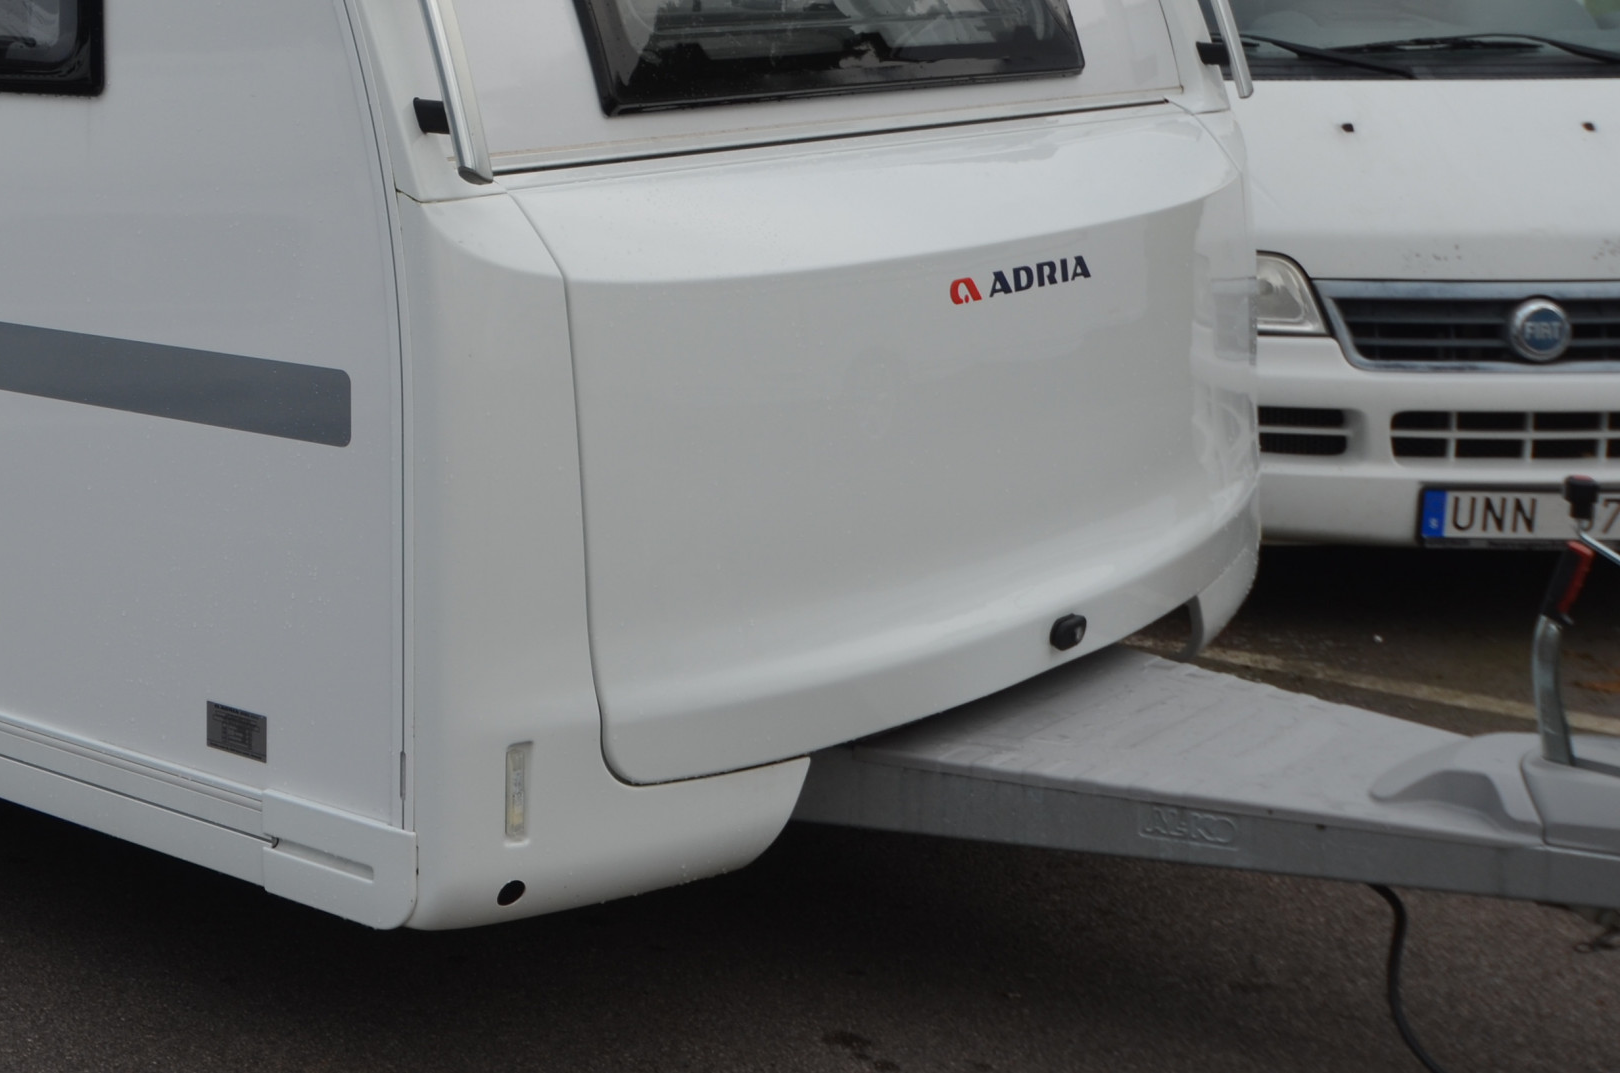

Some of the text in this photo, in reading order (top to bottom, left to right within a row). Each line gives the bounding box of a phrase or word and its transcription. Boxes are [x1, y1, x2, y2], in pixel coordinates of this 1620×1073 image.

[989, 255, 1091, 298] ADRIA
[1524, 321, 1561, 340] FIAT
[1452, 496, 1537, 533] UNN
